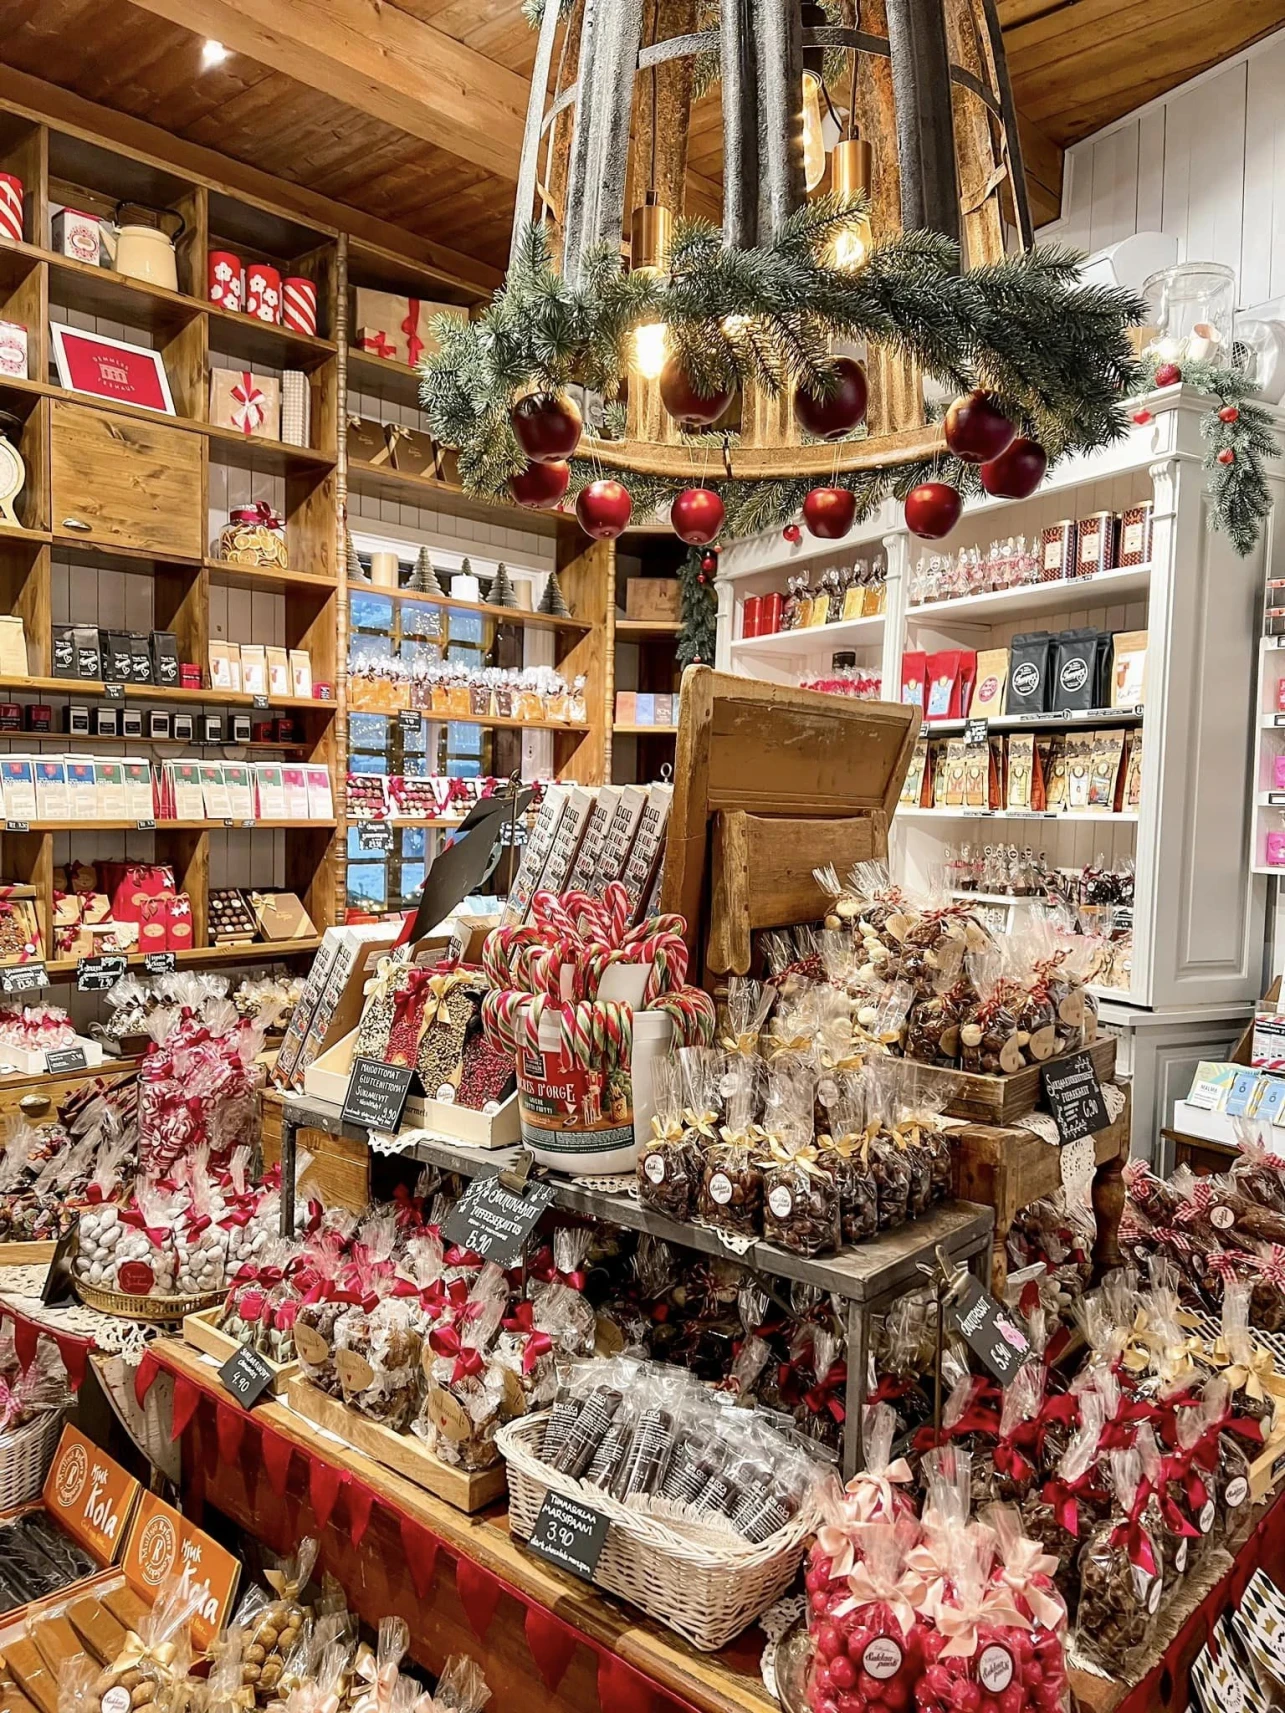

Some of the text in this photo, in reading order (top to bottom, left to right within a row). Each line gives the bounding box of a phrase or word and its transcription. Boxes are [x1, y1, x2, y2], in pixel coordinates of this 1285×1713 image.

[84, 1482, 118, 1539] Kola
[541, 1504, 593, 1536] MARSIPAANI
[546, 1521, 574, 1547] 3.90
[865, 1652, 893, 1662] Suklaa
